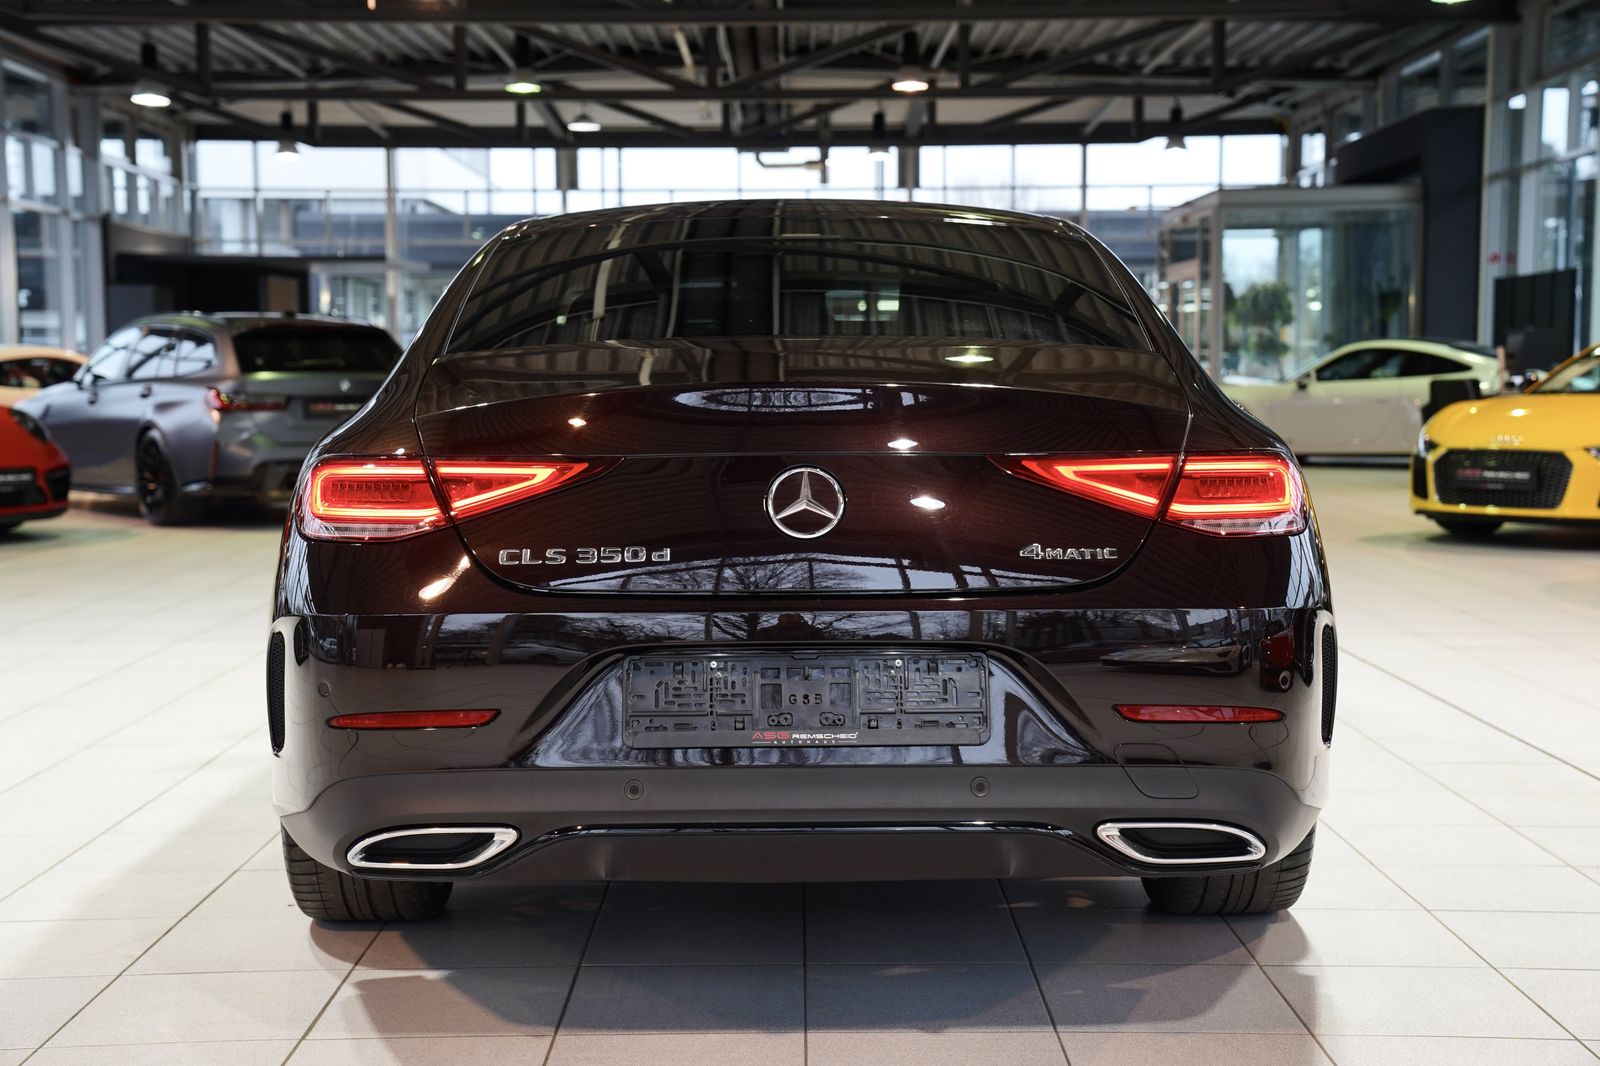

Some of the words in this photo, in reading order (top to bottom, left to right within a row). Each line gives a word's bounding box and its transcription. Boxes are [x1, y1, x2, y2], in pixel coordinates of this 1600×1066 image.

[498, 548, 567, 566] CLS
[1019, 543, 1118, 560] 4MATIC
[752, 731, 791, 740] ASG
